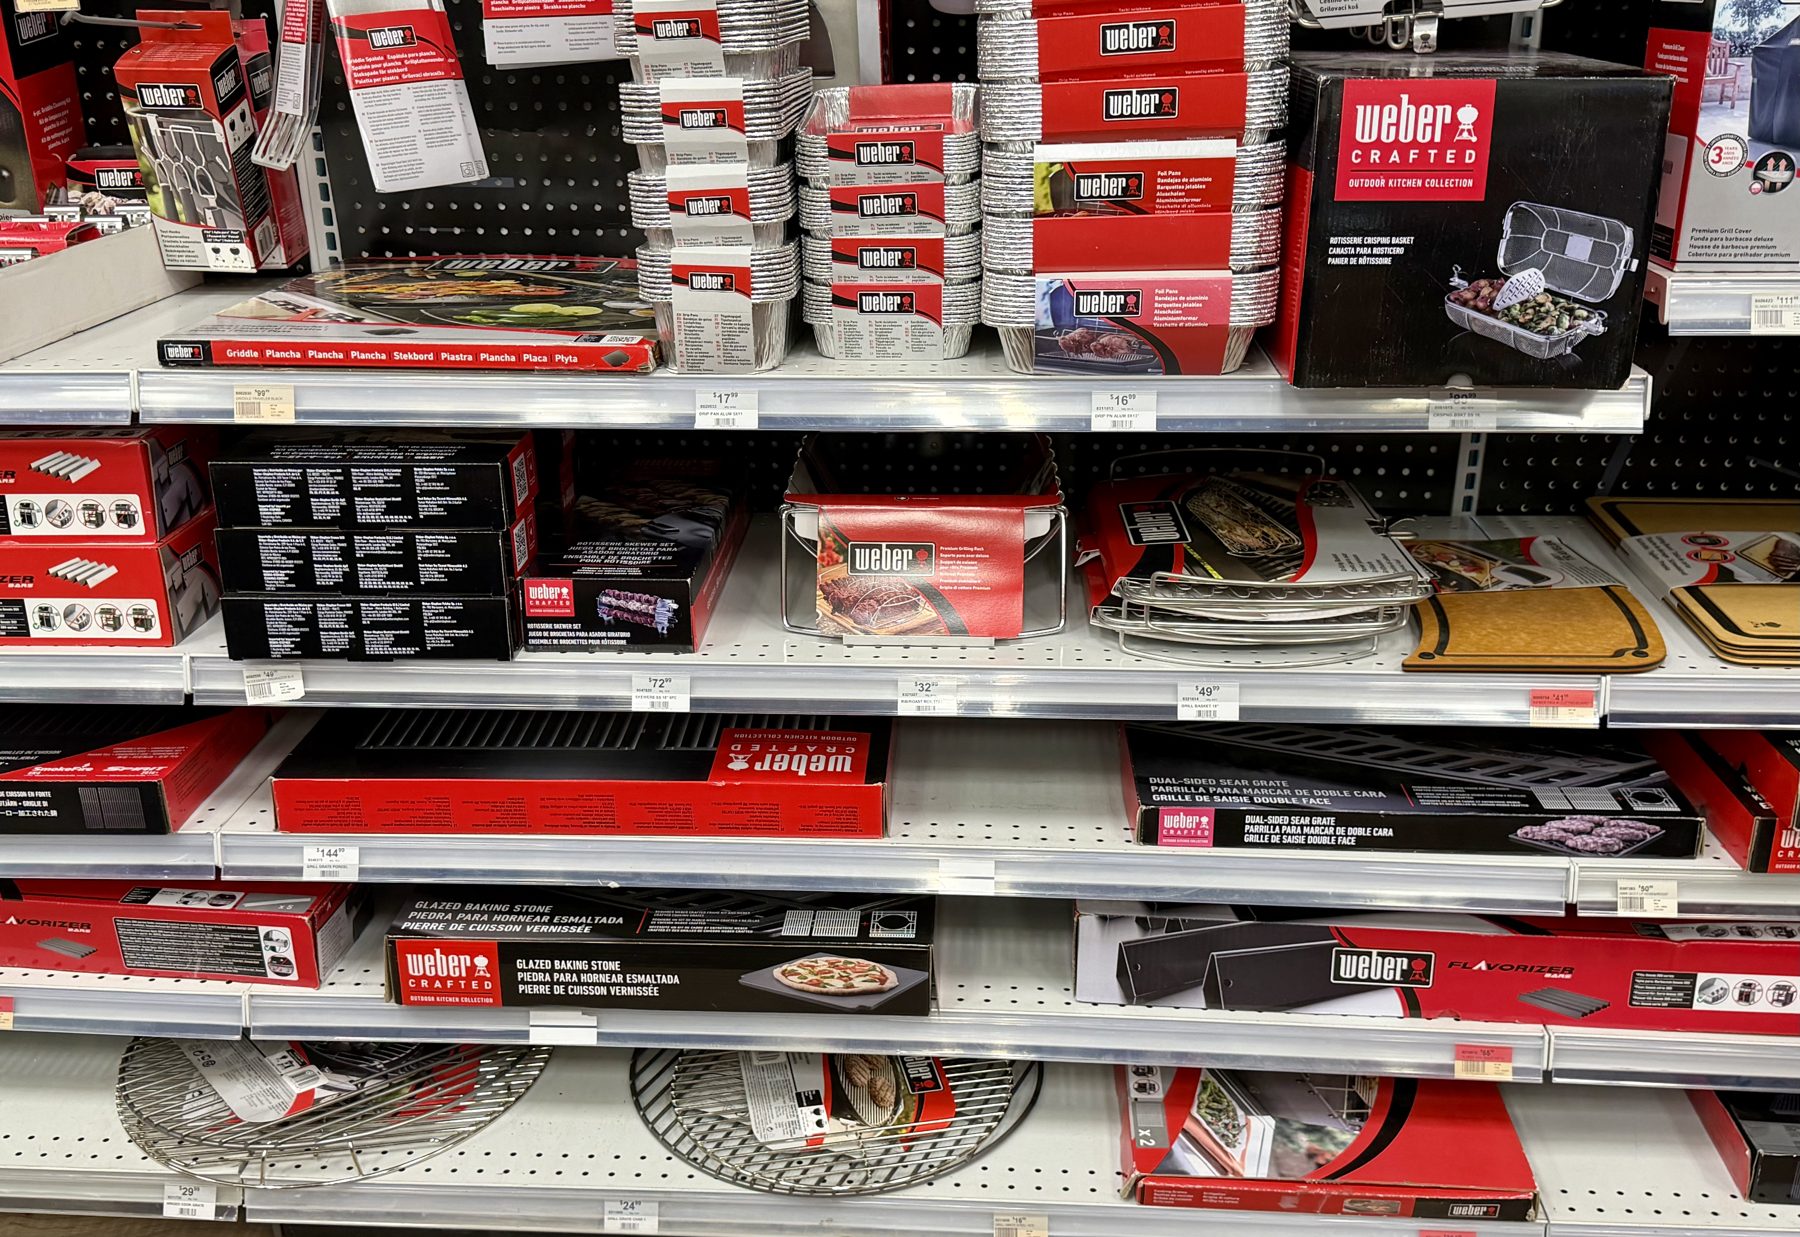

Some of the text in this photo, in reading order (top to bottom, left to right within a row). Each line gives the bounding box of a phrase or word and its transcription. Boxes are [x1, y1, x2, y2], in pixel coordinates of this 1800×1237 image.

[18, 12, 47, 40] weber
[656, 20, 689, 38] weber
[371, 28, 405, 48] weber
[1106, 24, 1156, 50] weber
[218, 75, 236, 97] weber
[141, 84, 185, 106] weber
[1109, 90, 1159, 116] weber
[683, 110, 716, 128] weber
[1355, 94, 1452, 144] weber
[859, 142, 901, 164] weber
[1351, 150, 1476, 164] CRAFTED
[1711, 146, 1723, 164] 3
[99, 168, 133, 187] weber
[1079, 174, 1126, 197] weber
[1349, 178, 1473, 188] OUTDOOR KITCHEN COLLECTION
[688, 198, 720, 215] weber
[862, 195, 903, 215] weber
[1330, 236, 1415, 245] ROTISSERIE CRISPING BASKET
[862, 248, 902, 268] weber
[1329, 247, 1355, 255] CANASTA
[1372, 247, 1405, 255] ROSTICERO
[444, 258, 569, 270] weber
[1328, 257, 1349, 265] PANIER
[1349, 257, 1358, 265] DE
[692, 274, 723, 290] weber
[862, 292, 901, 312] weber
[1079, 290, 1125, 313] weber
[167, 345, 193, 359] weber
[226, 349, 259, 358] Griddle
[266, 350, 301, 358] Plancha
[308, 350, 343, 359] Plancha
[351, 351, 386, 360] Plancha
[394, 352, 434, 361] Stekbord
[441, 352, 473, 362] Piastra
[480, 353, 516, 362] Plancha
[523, 354, 547, 363] Placa
[1133, 510, 1180, 542] weber
[855, 543, 913, 571] weber
[529, 584, 560, 599] weber
[730, 744, 856, 753] CRAFTED
[754, 753, 852, 775] weber
[1149, 777, 1216, 786] DUAL-SIDED
[1151, 786, 1206, 794] PARRILLA
[1164, 812, 1199, 828] weber
[1245, 815, 1335, 826] DUAL-SIDED SEAR GRATE
[1245, 825, 1394, 837] PARRILLA PARA MARCAR DE DOBLE CARA
[1244, 834, 1356, 845] GRILLE DE SAISIE DOUBLE FACE
[415, 901, 553, 913] GLAZED BAKING STONE
[408, 912, 624, 924] PIEDRA PARA HORNEAR ESMALTADA
[401, 922, 592, 933] PIERRE DE CUISSON VERNISSÉE
[406, 948, 471, 977] weber
[516, 959, 621, 971] GLAZED BAKING STONE
[1340, 950, 1408, 982] weber
[1447, 960, 1576, 974] FLAVORIZER
[408, 979, 492, 990] CRAFTED
[518, 972, 680, 985] PIEDRA PARA HORNEAR ESMALTADA
[518, 984, 659, 996] PIERRE DE CUISSON VERNISSÉE
[1452, 1204, 1488, 1216] weber
